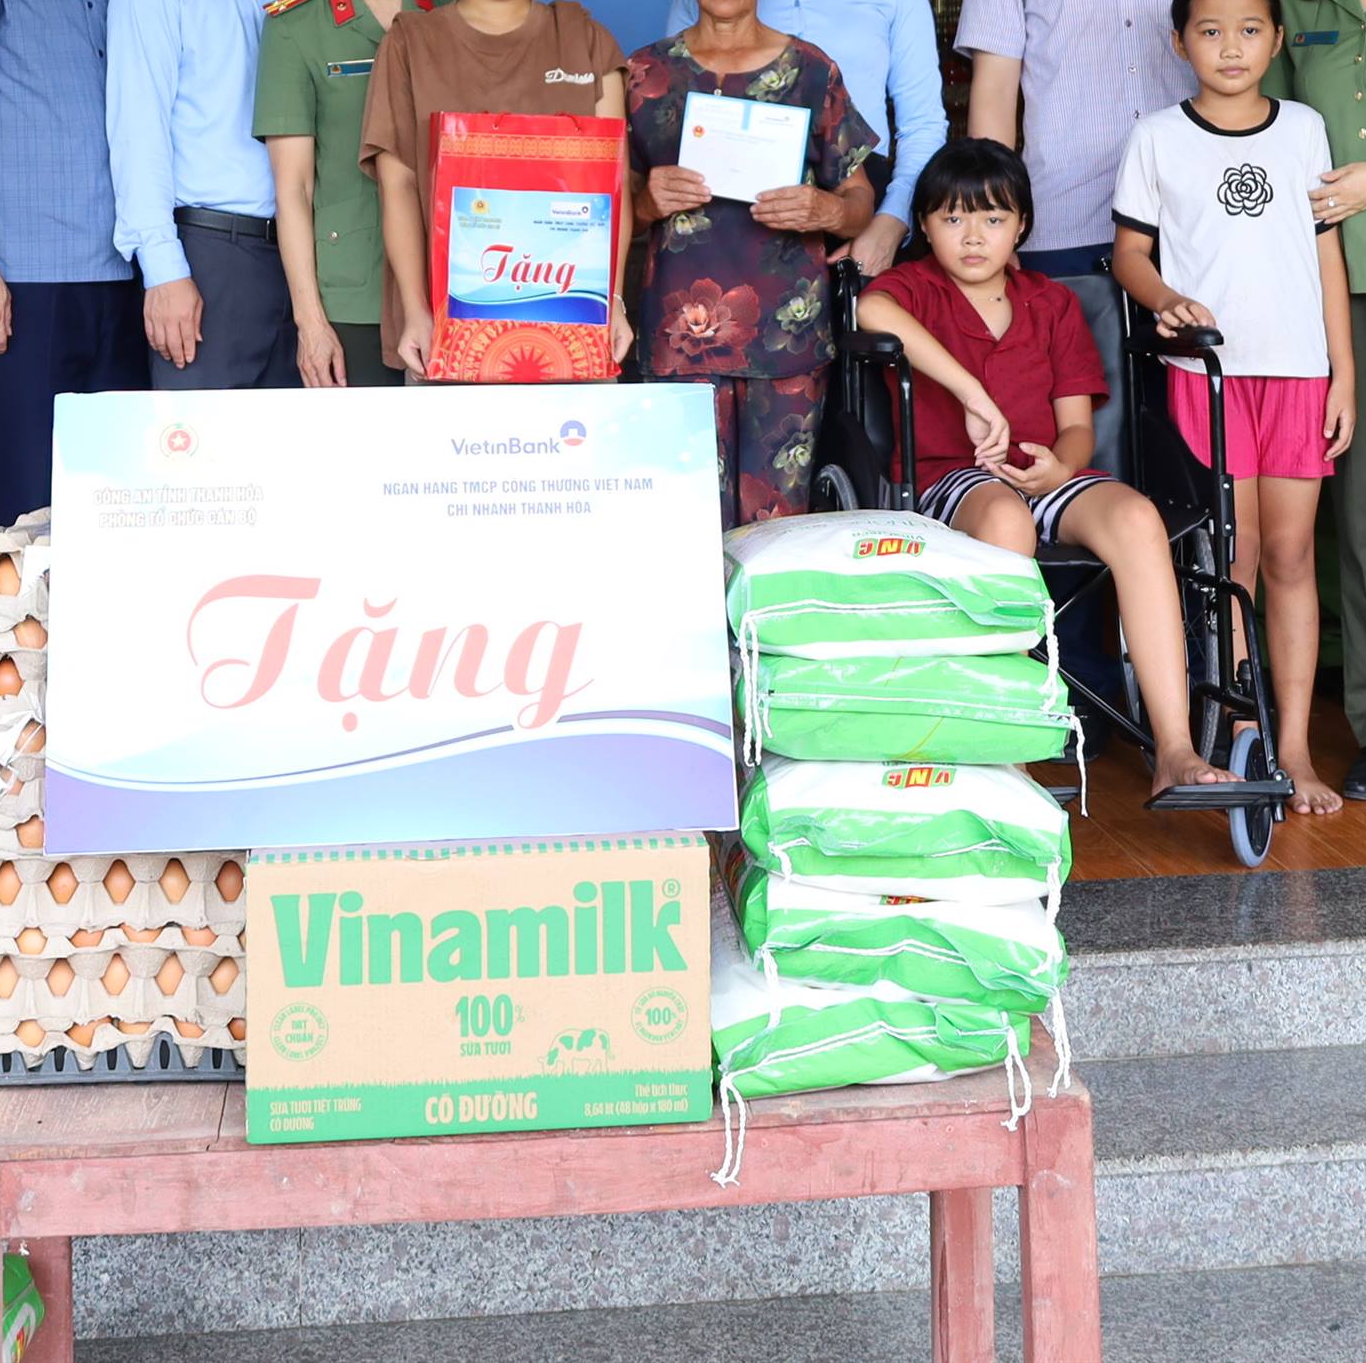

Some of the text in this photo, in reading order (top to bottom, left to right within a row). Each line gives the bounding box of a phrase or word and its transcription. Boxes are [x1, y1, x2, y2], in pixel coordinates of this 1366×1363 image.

[481, 244, 578, 294] Tặng
[451, 437, 561, 455] VietinBank
[189, 486, 234, 503] THANH
[463, 480, 497, 495] TMCP
[624, 477, 653, 492] NAM
[447, 502, 468, 517] CHI
[521, 500, 562, 515] THANH
[187, 574, 594, 730] Tặng
[458, 1090, 538, 1123] ĐƯỜNG
